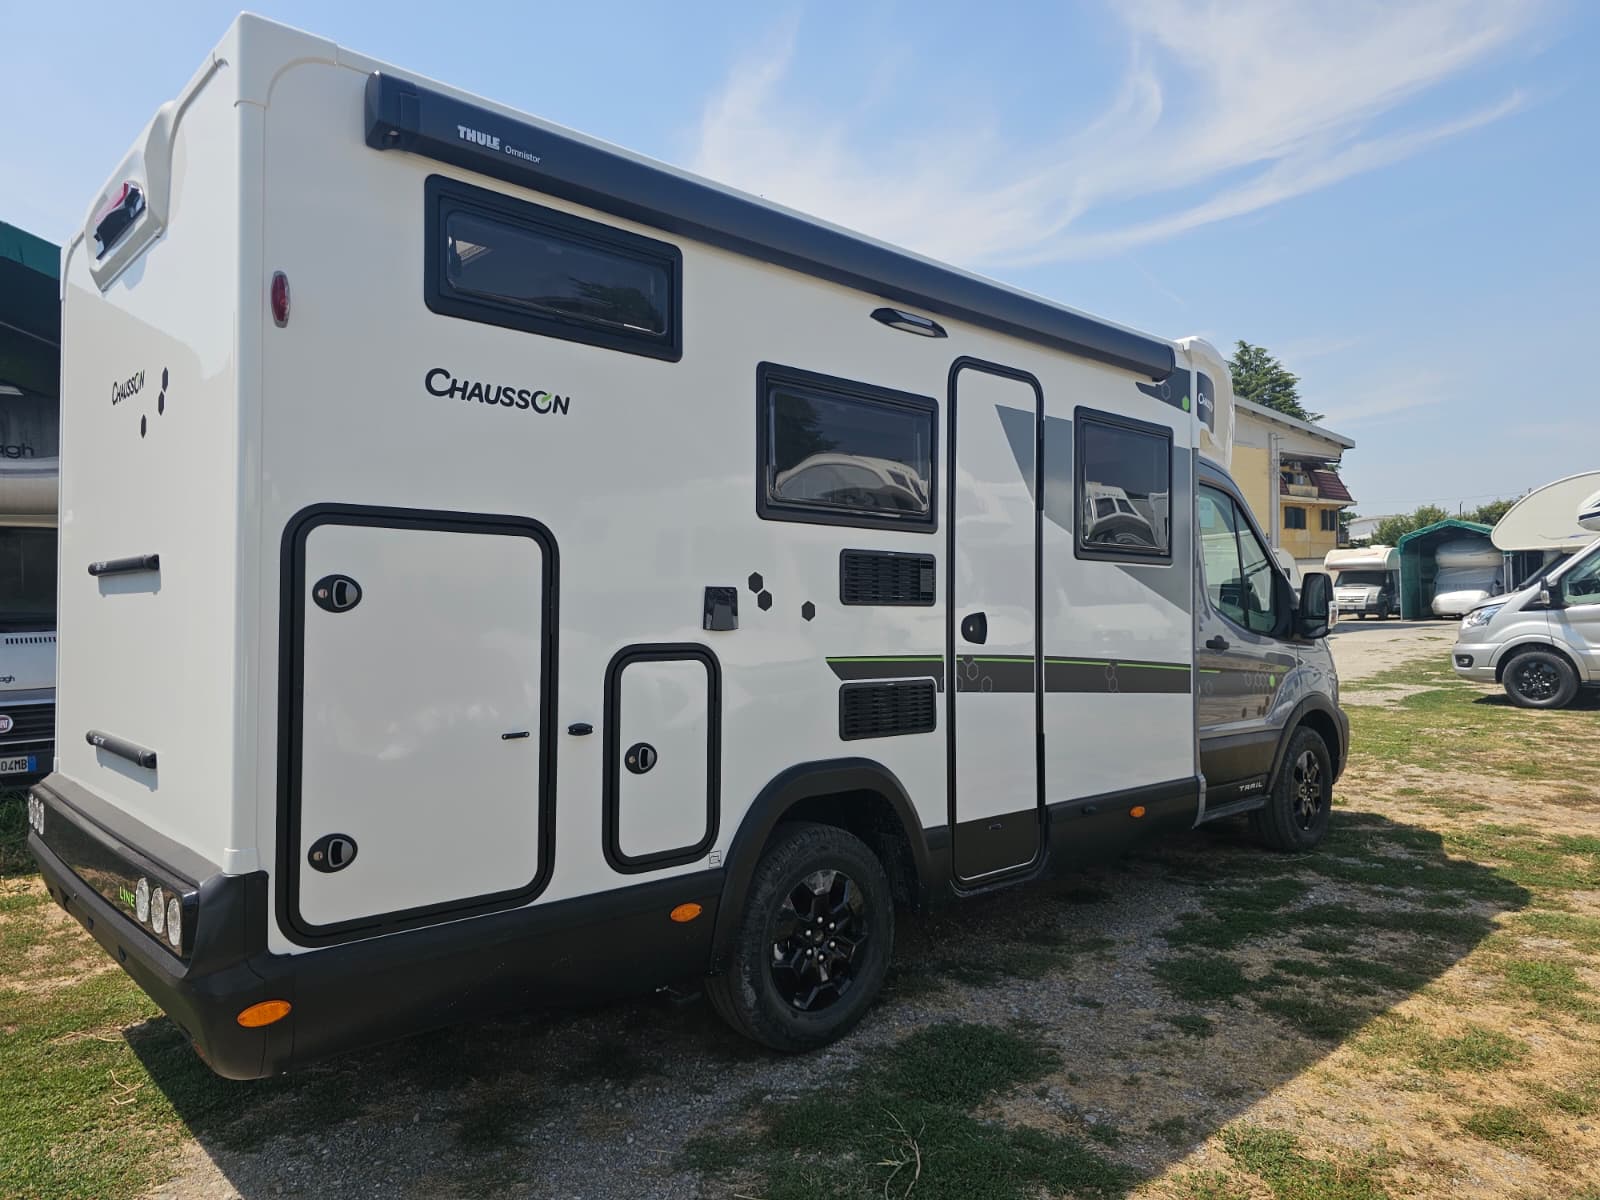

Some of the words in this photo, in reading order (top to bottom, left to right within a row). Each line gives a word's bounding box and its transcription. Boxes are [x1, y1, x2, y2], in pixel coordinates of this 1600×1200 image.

[457, 125, 500, 151] THULE
[504, 145, 541, 164] Omnistor
[425, 367, 571, 415] CHAUSSON
[119, 886, 136, 908] LINE
